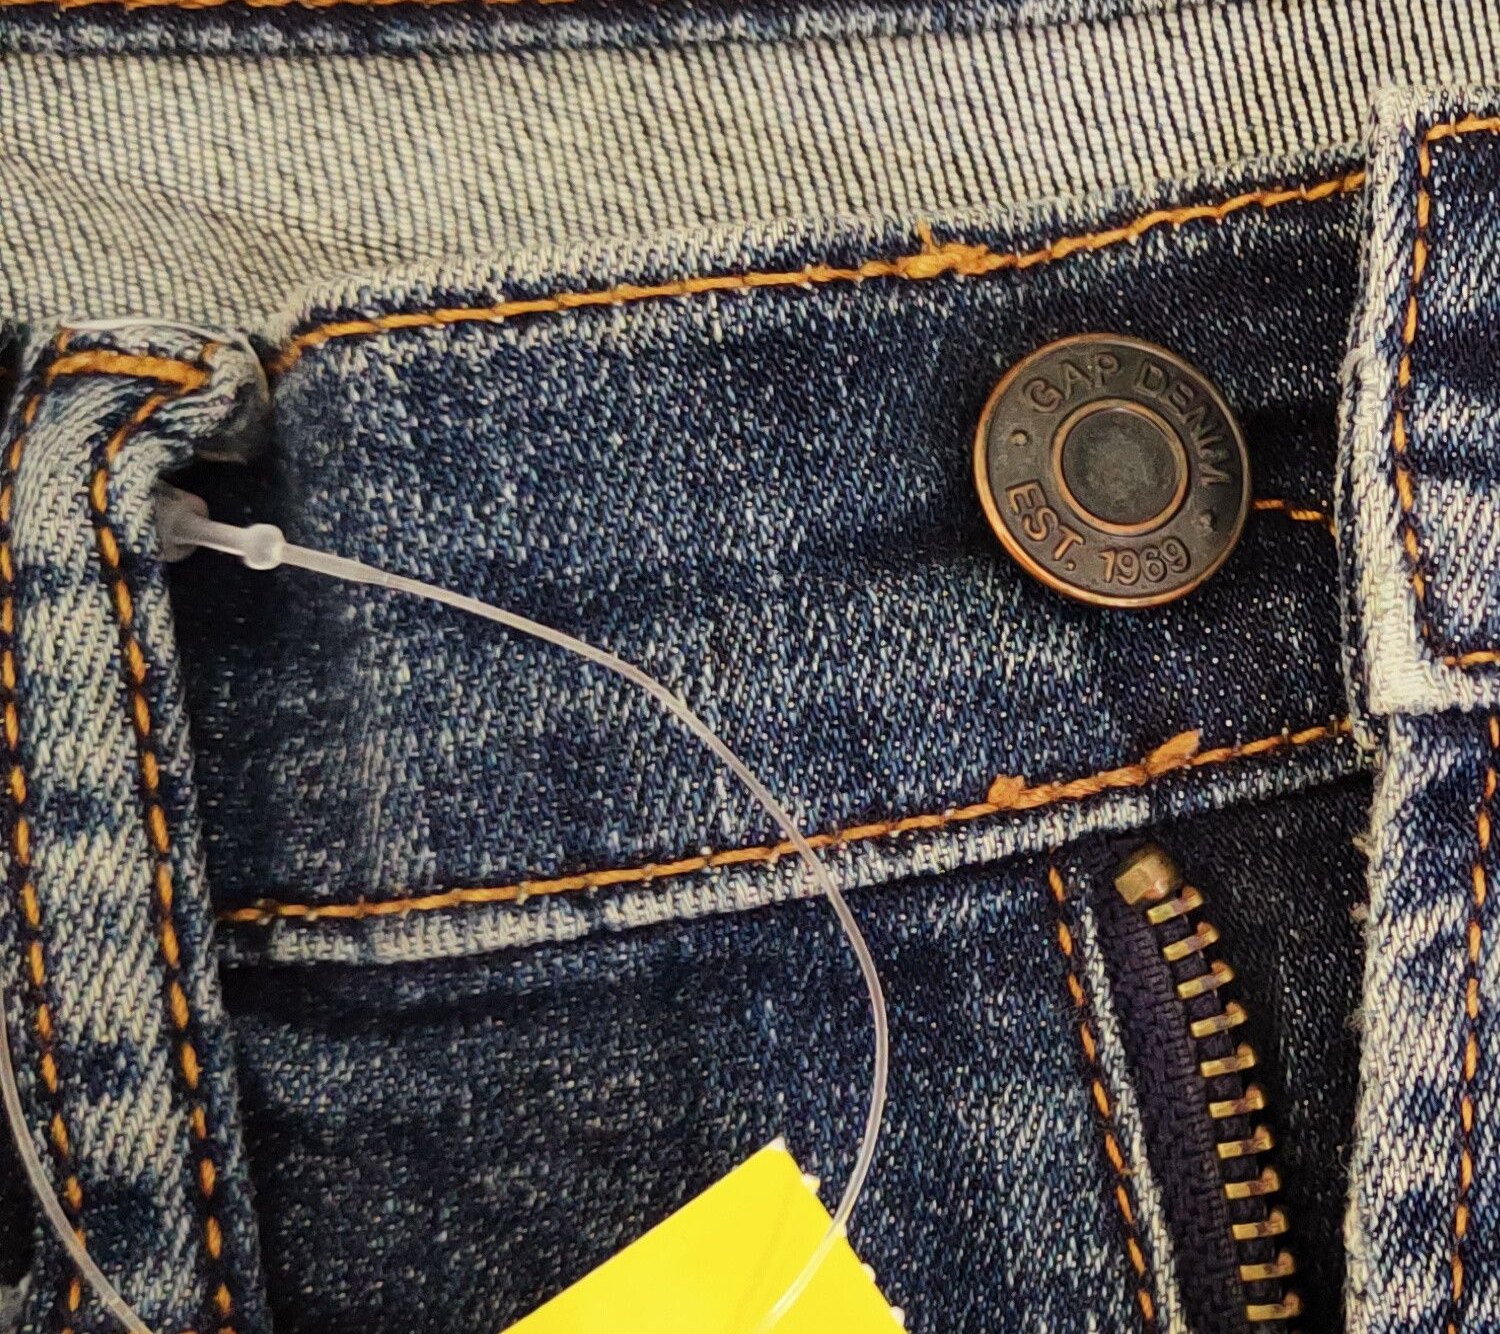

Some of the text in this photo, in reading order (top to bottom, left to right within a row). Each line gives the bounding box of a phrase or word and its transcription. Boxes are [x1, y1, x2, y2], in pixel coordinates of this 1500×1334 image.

[1022, 351, 1122, 414] GAP
[1005, 477, 1192, 587] EST. 1969
